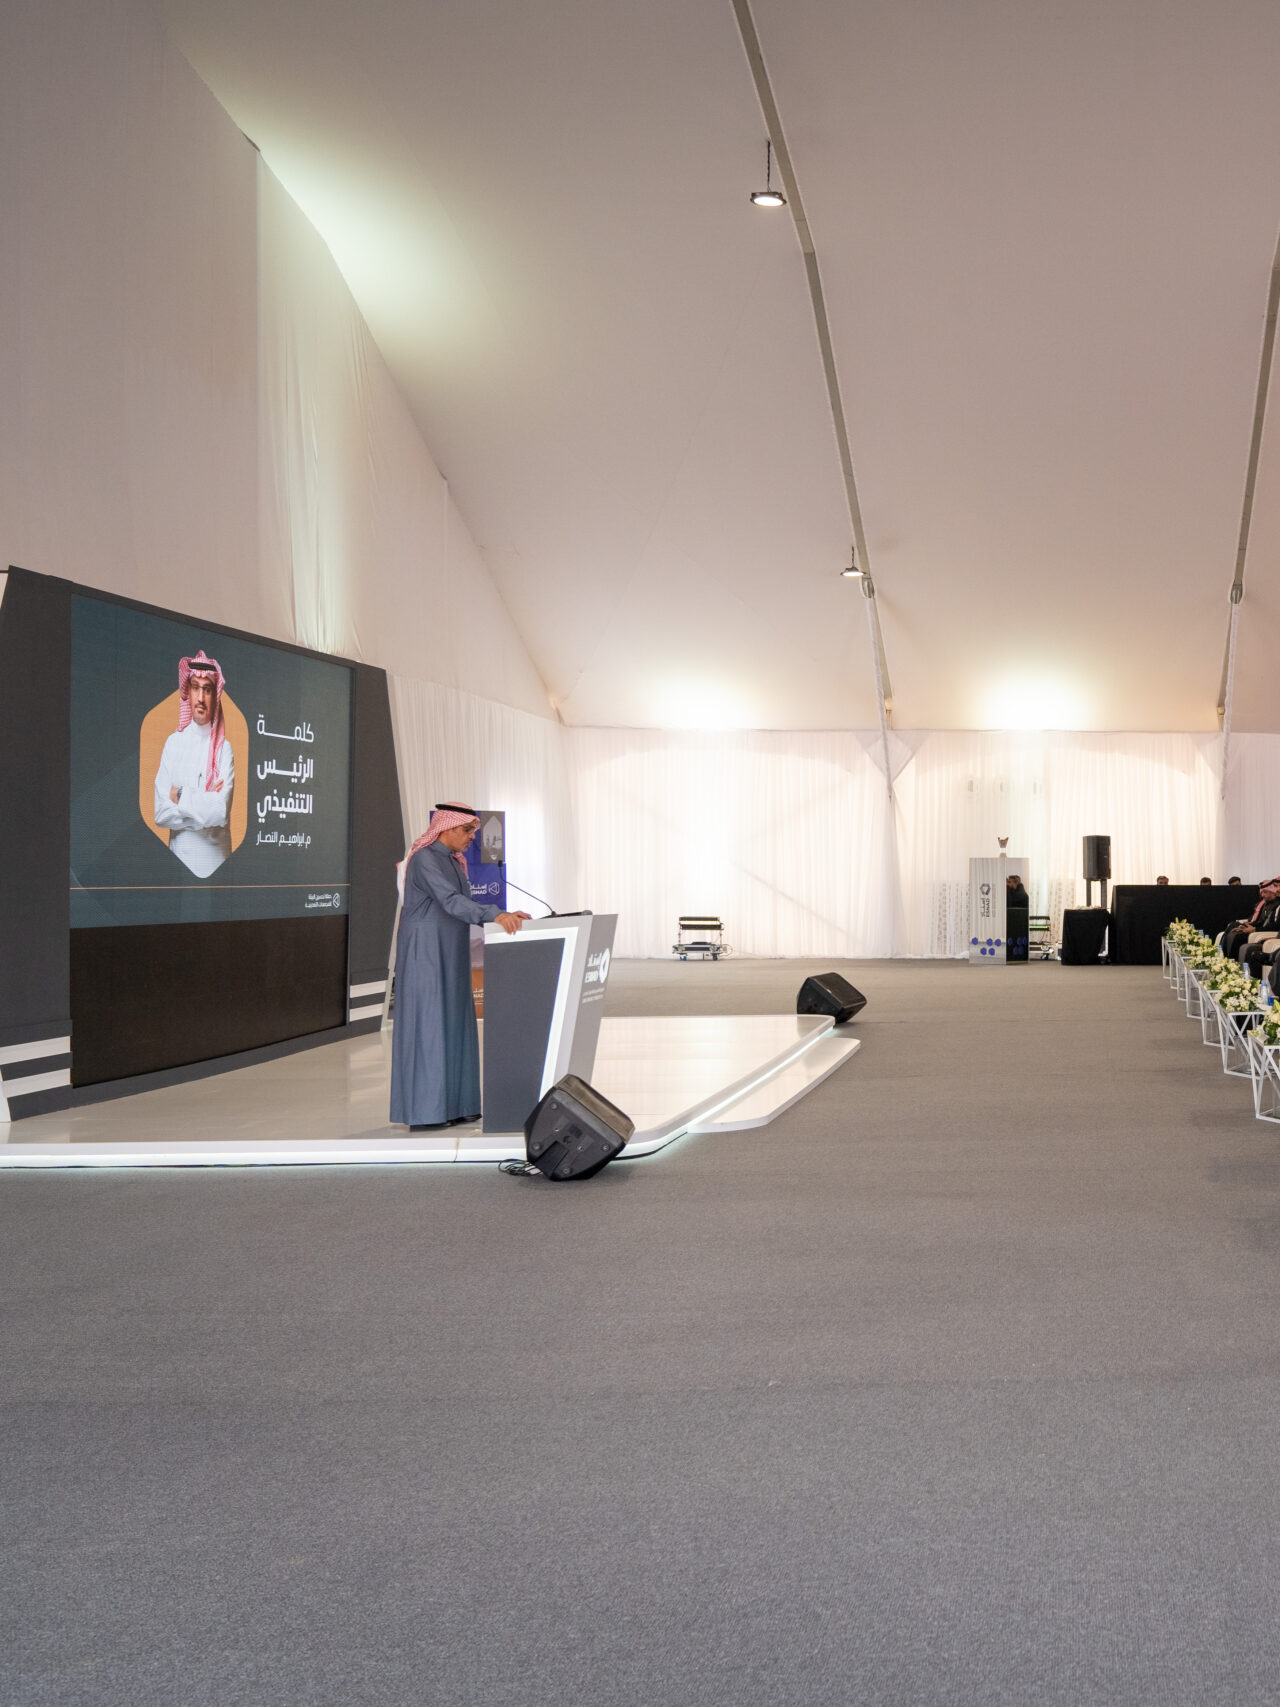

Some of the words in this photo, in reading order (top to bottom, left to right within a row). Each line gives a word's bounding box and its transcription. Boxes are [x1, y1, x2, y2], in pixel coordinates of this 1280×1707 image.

[256, 713, 314, 743] كلمة
[256, 754, 314, 783] الرئيس
[256, 788, 313, 823] التنفيذي
[255, 830, 278, 846] النصار
